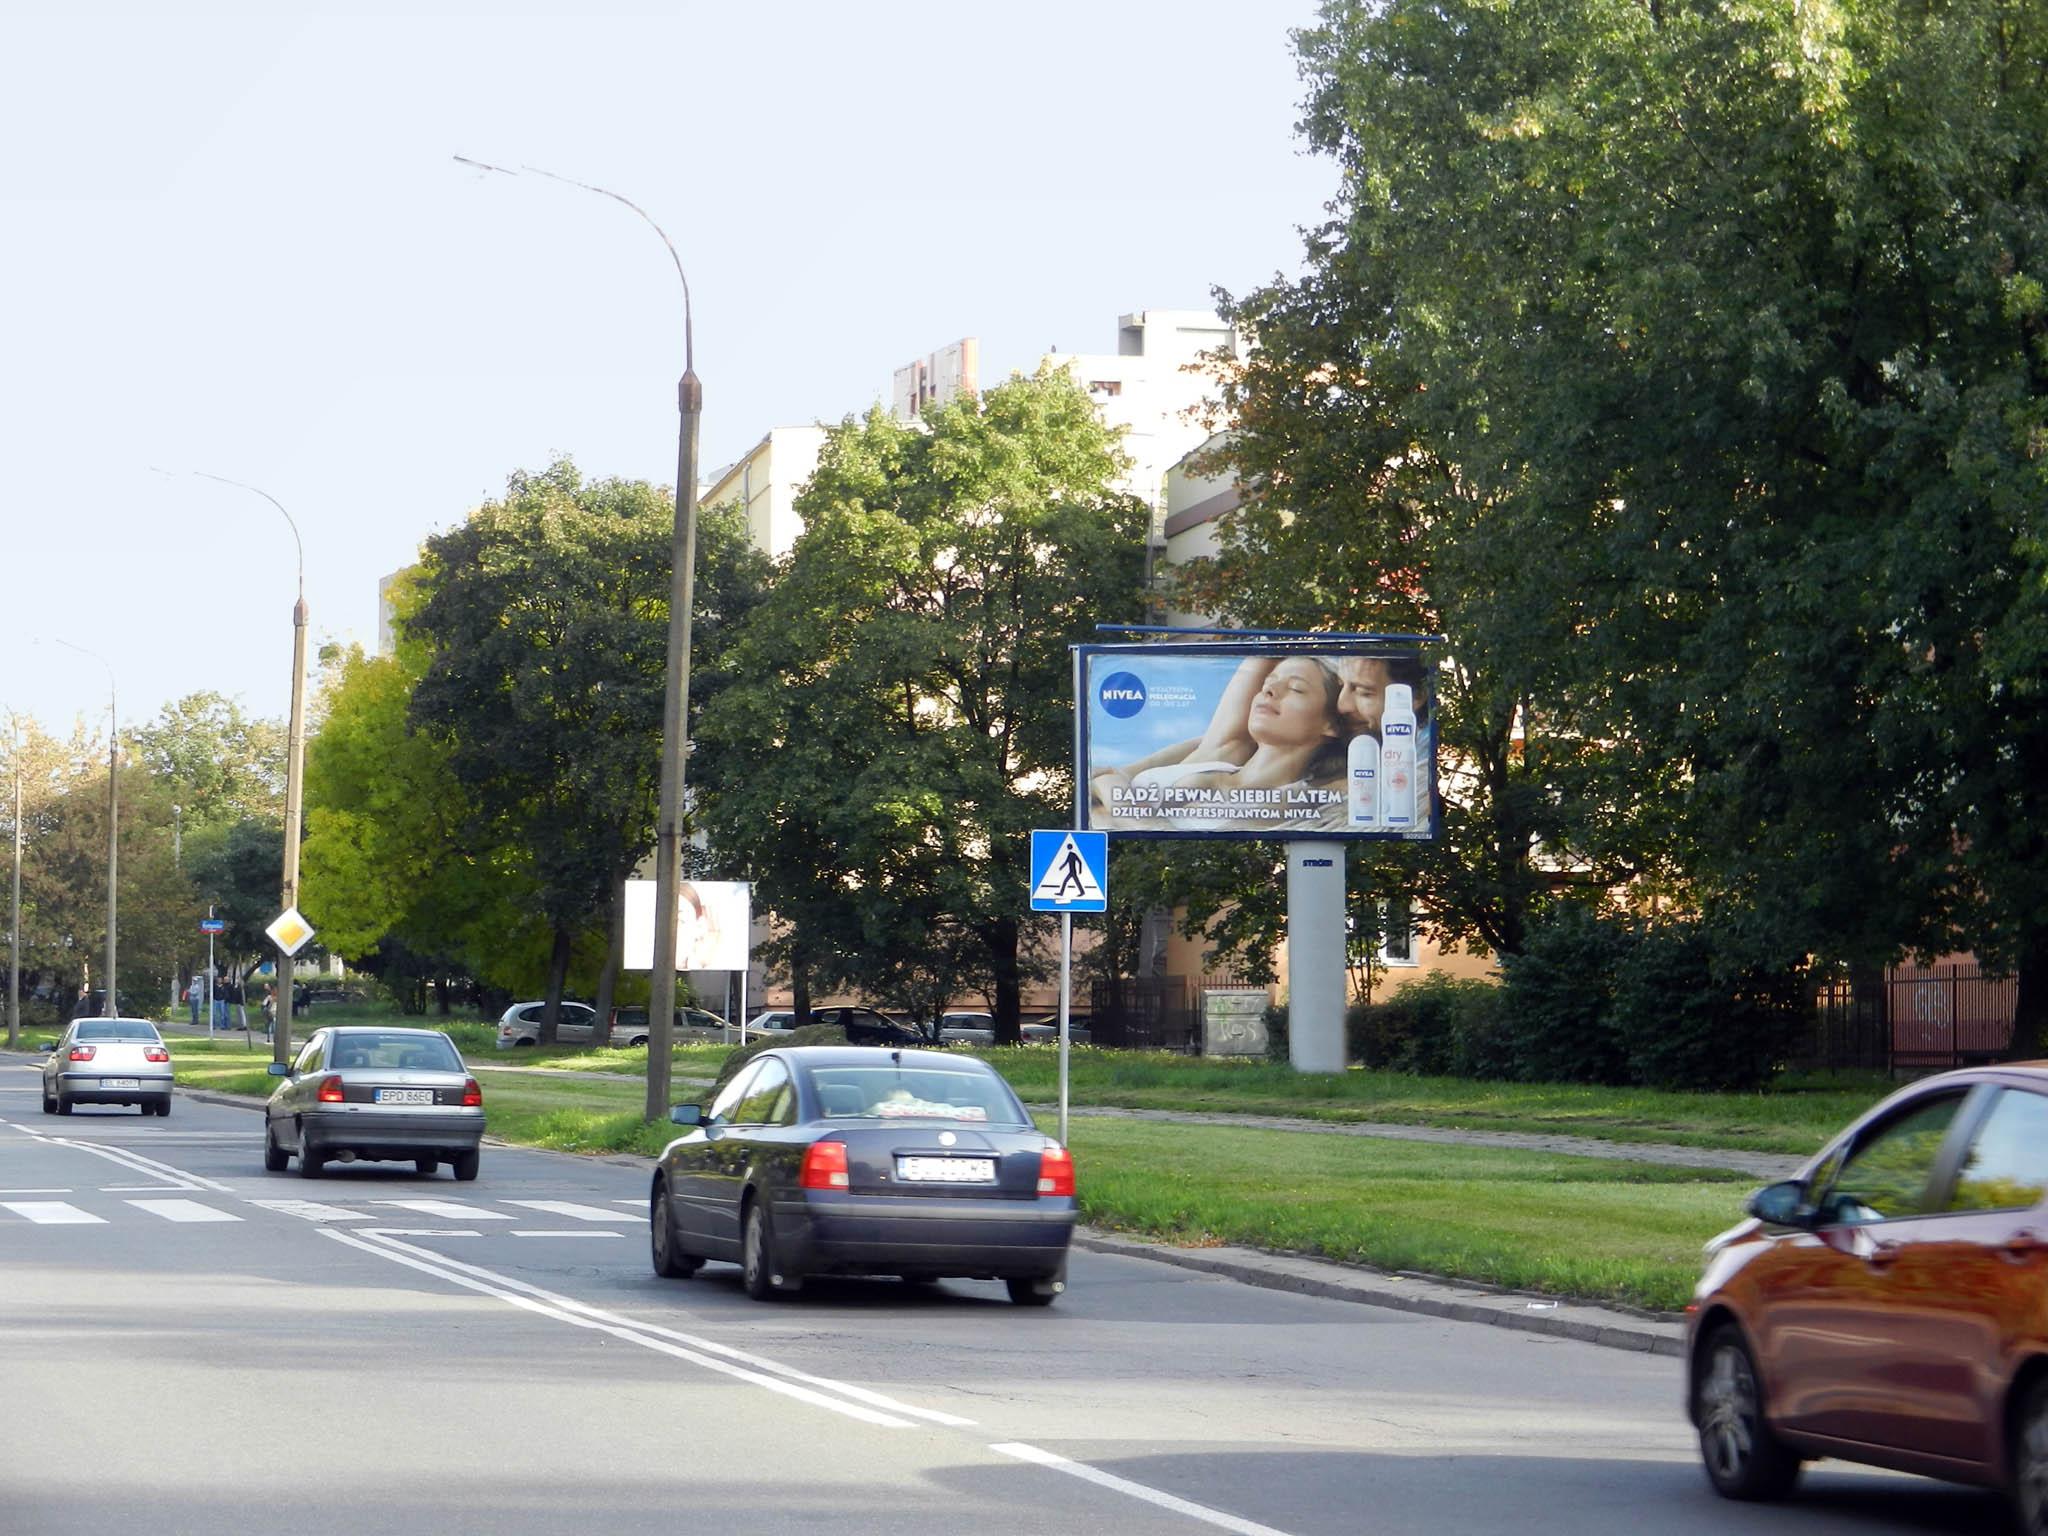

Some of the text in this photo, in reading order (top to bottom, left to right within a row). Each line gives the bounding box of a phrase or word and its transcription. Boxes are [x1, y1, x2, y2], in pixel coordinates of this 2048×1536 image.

[1102, 689, 1144, 700] NIVEA
[1387, 726, 1411, 734] NIVEA
[1384, 750, 1402, 760] dry
[1112, 784, 1342, 805] BĄDŹ PEWNA SIEBIE LATEM
[1112, 807, 1321, 819] DZIĘKI ANTYPERSPIRANTOM NIVEA
[382, 1090, 404, 1101] EPD
